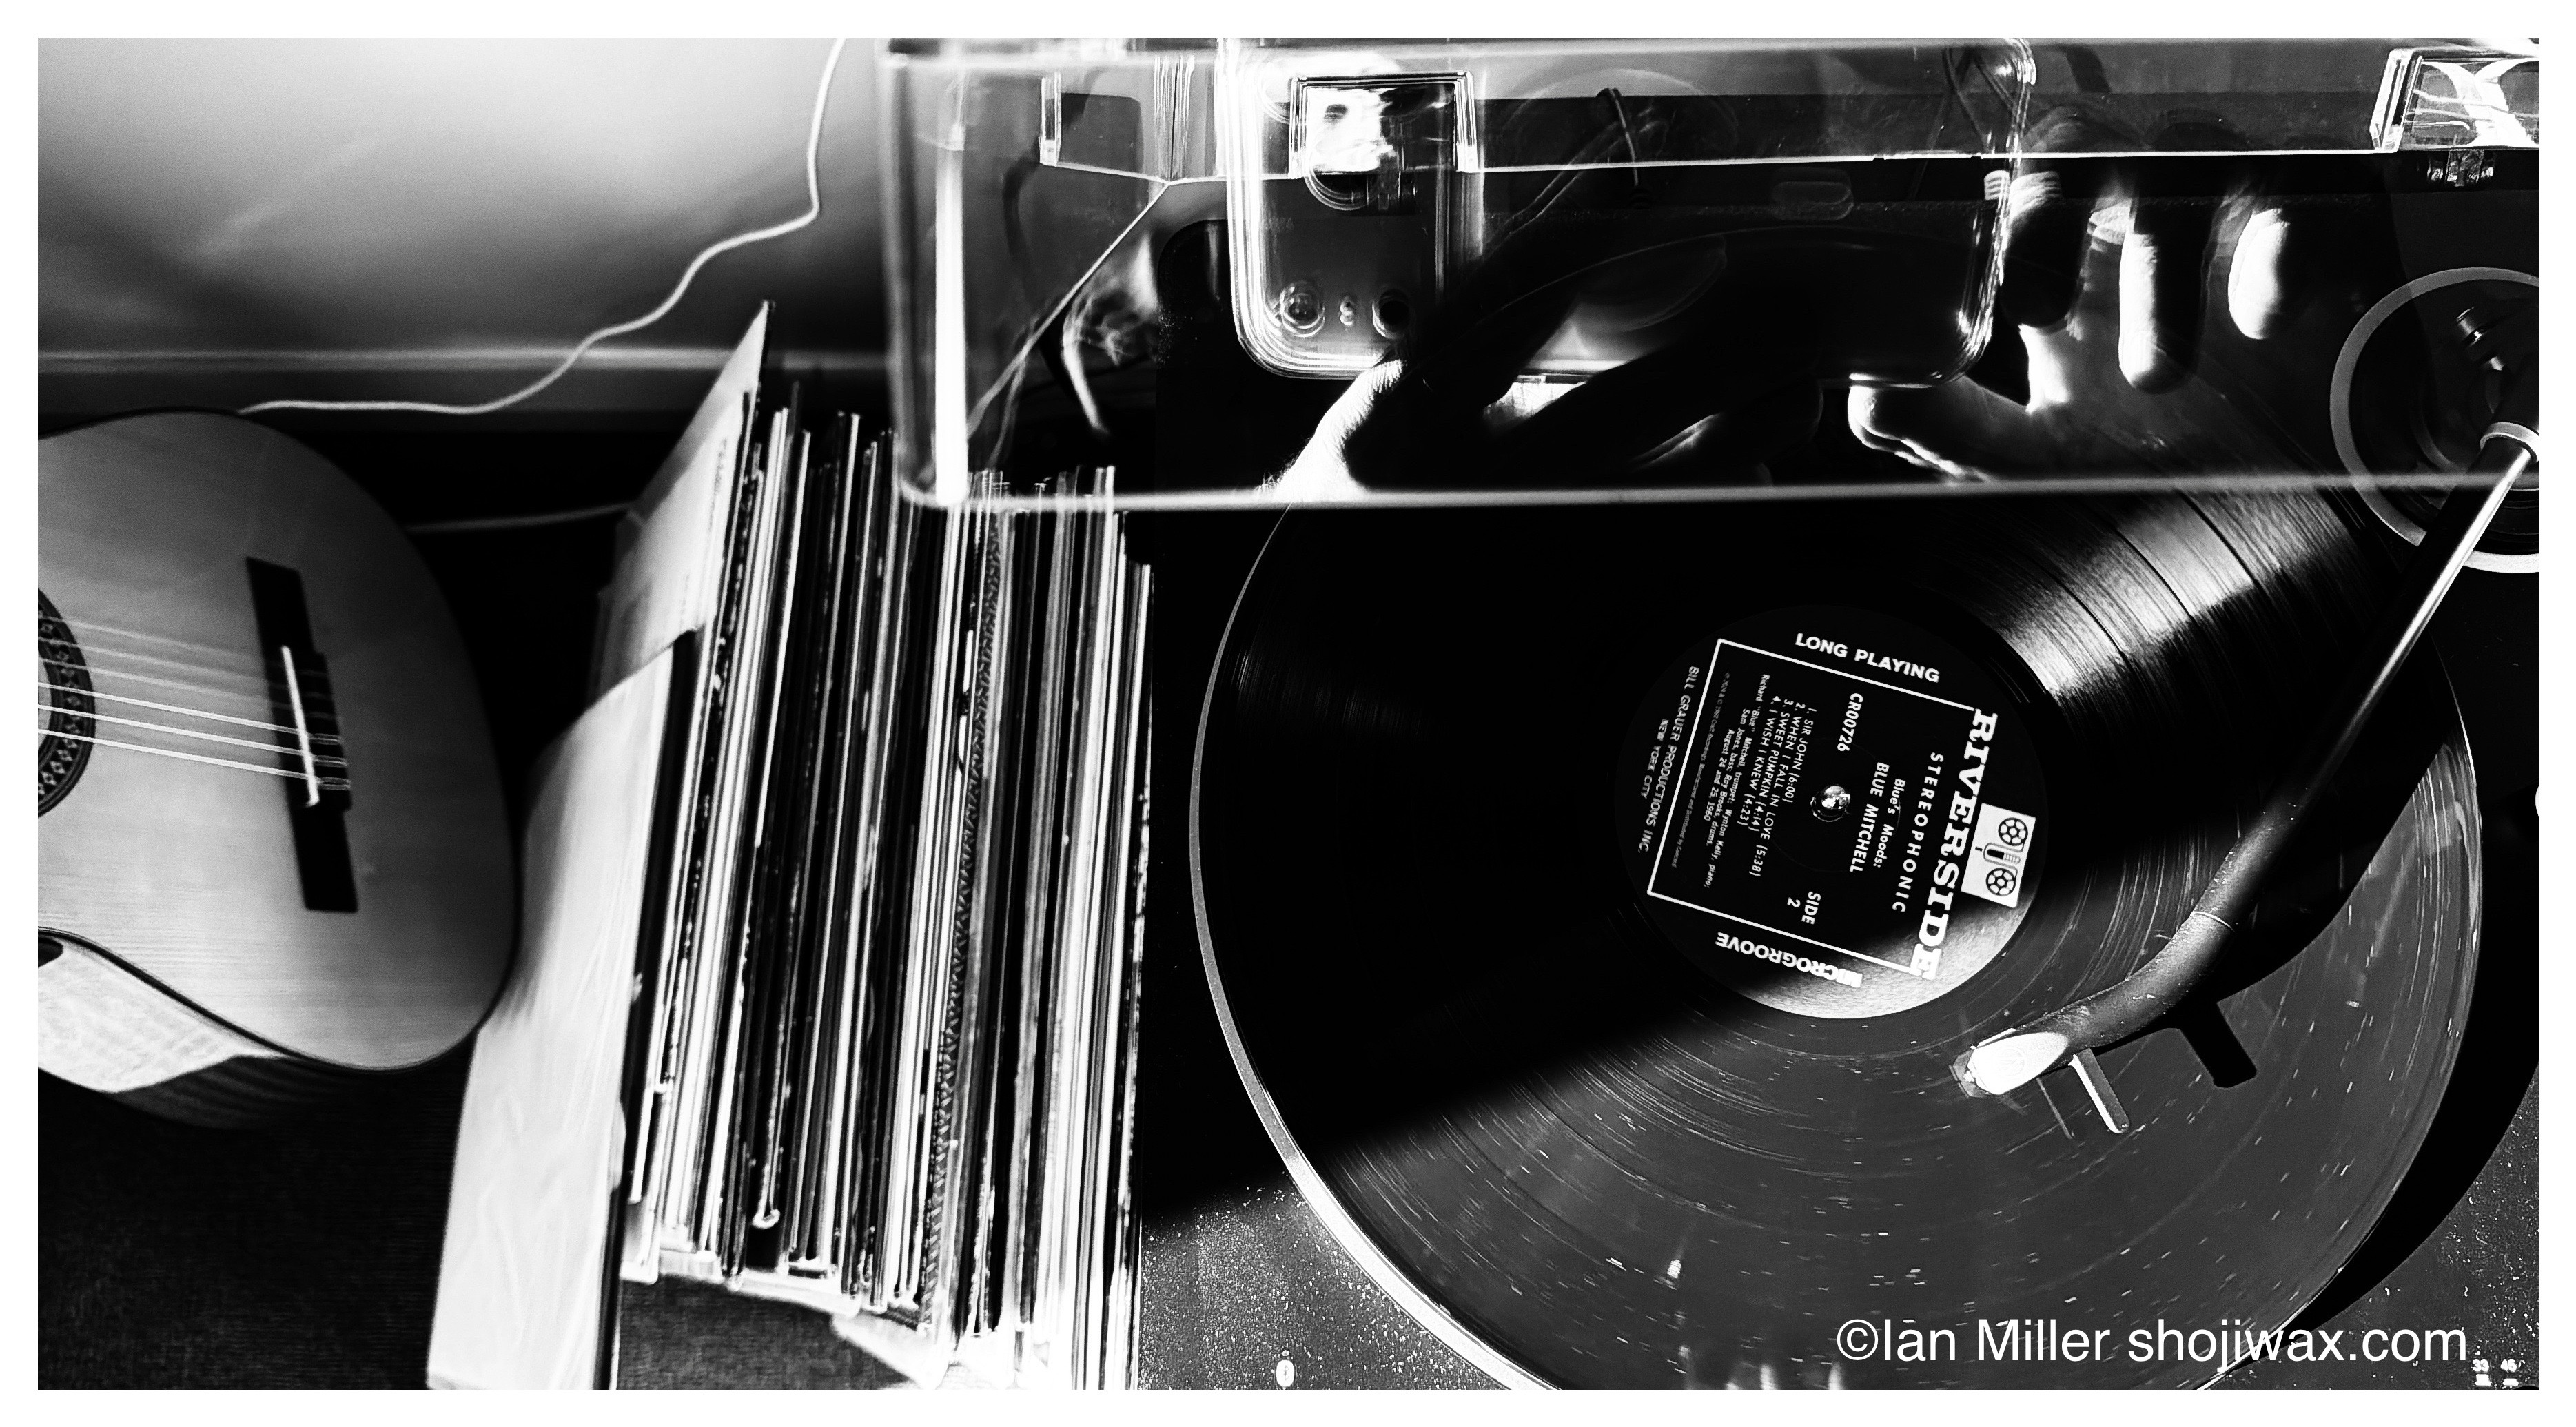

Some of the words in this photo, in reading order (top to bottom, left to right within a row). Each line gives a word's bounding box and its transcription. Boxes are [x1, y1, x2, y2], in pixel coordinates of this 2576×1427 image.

[1795, 633, 1848, 658] LONG
[1854, 648, 1940, 684] PLAYING
[1684, 666, 1700, 690] BILL
[1755, 674, 1770, 702] Richard
[1770, 695, 1781, 704] 4.
[1782, 699, 1795, 708] 3.
[1794, 702, 1806, 711] 2.
[1656, 719, 1669, 742] NEW
[1670, 695, 1692, 741] GRAUER
[1739, 708, 1751, 725] Sam
[1772, 711, 1790, 748] SWEET
[1801, 719, 1814, 735] SIR
[1837, 692, 1863, 752] CR00726
[1721, 728, 1735, 755] August
[1759, 717, 1777, 746] WISH
[1784, 716, 1802, 750] WHEN
[1647, 746, 1662, 772] YORK
[1718, 757, 1728, 768] 24
[1792, 737, 1808, 770] JOHN
[1640, 774, 1653, 799] CITY
[1646, 744, 1677, 827] PRODUCTIONS
[1713, 769, 1722, 786] and
[1721, 774, 1732, 789] Roy
[1749, 756, 1766, 790] KNEW
[1759, 749, 1780, 798] PUMPKIN
[1773, 763, 1789, 788] FALL
[1781, 772, 1801, 803] (6:00)
[1870, 762, 1890, 797] BLUE
[1737, 793, 1756, 826] (4:23)
[1769, 794, 1781, 808] IN
[1887, 778, 1906, 814] Blue's
[1704, 801, 1715, 821] 1960
[1719, 808, 1733, 836] Wynton
[1748, 801, 1767, 832] (4:14)
[1760, 811, 1776, 840] LOVE
[1849, 803, 1879, 872] MITCHELL
[1873, 823, 1894, 868] Moods:
[1892, 752, 1944, 912] STEREOPHONIC
[1907, 708, 1998, 981] RIVERSIDE
[1748, 844, 1768, 877] (5:38)
[1787, 897, 1801, 908] 2
[1801, 891, 1821, 925] SIDE
[1714, 931, 1863, 989] MICROGROOVE
[2472, 1359, 2490, 1373] 33
[2500, 1359, 2518, 1373] 45
